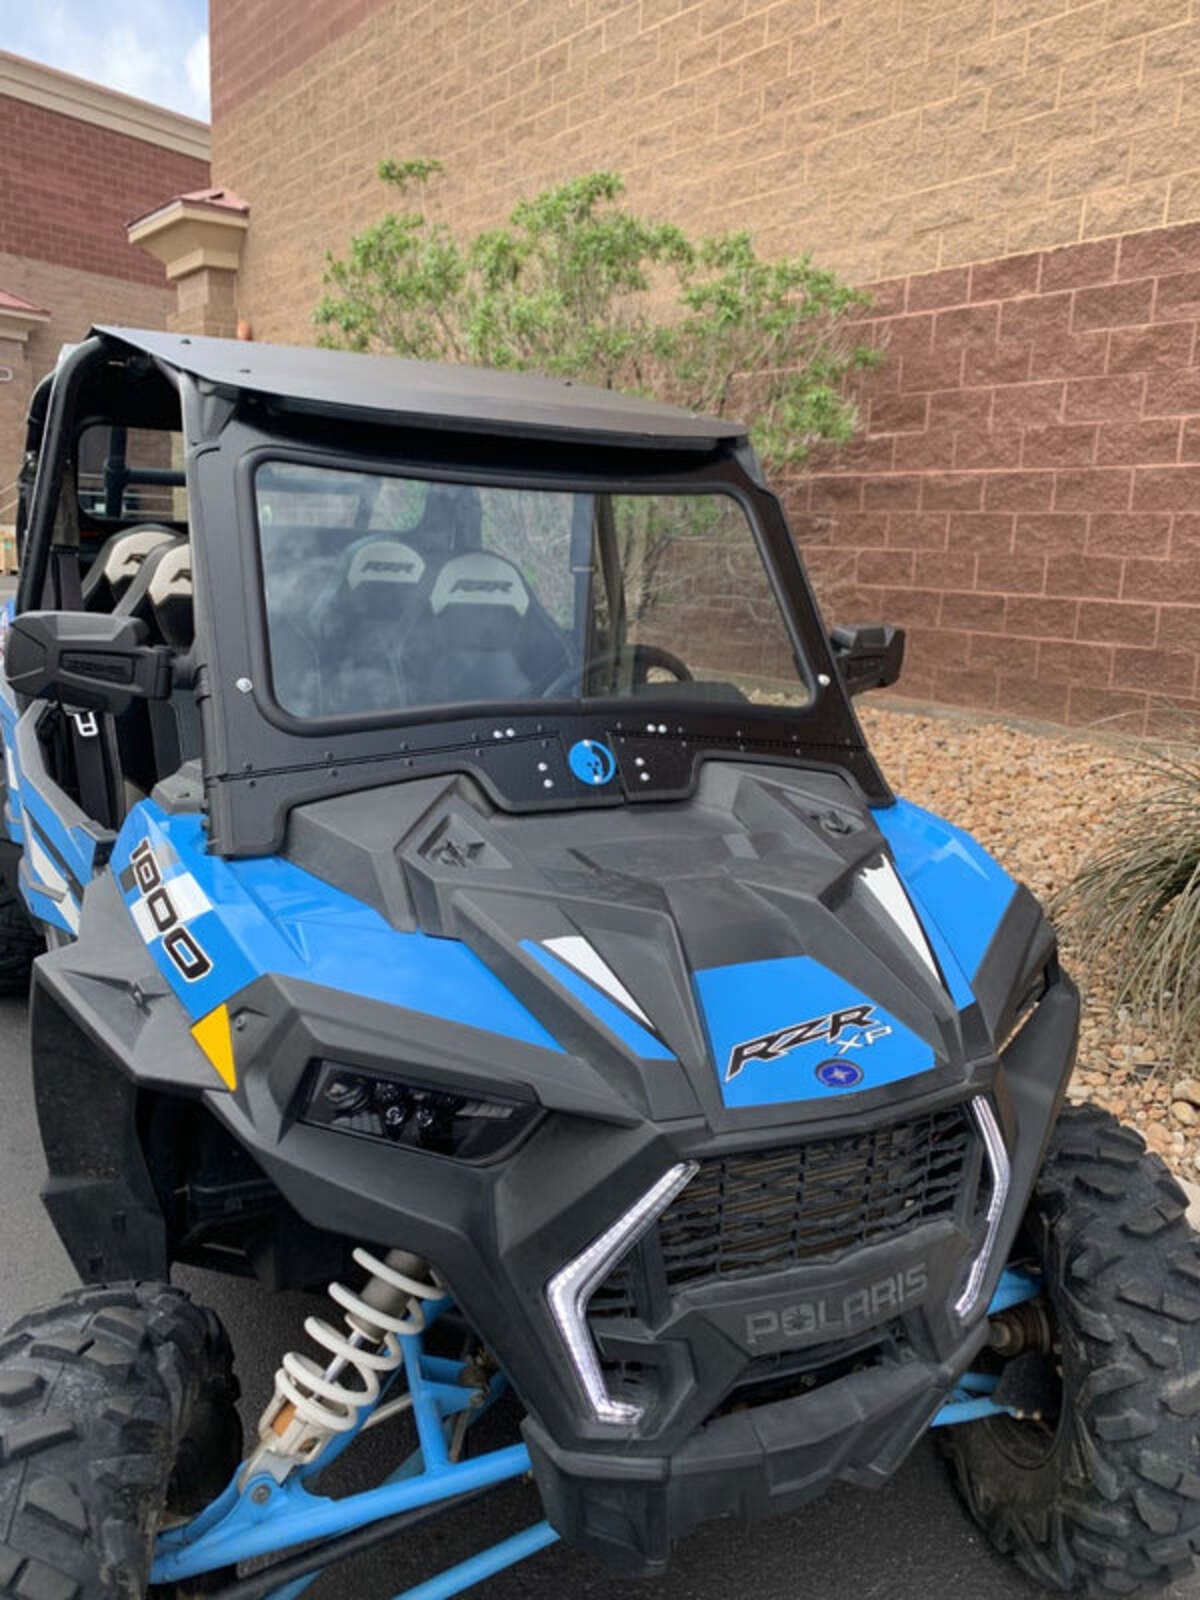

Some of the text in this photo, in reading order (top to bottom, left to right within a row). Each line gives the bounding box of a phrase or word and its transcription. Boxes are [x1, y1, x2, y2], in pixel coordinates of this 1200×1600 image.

[129, 835, 213, 983] 1000
[725, 1003, 879, 1082] RZR
[834, 1025, 892, 1056] XP
[745, 1262, 929, 1345] POLARIS
